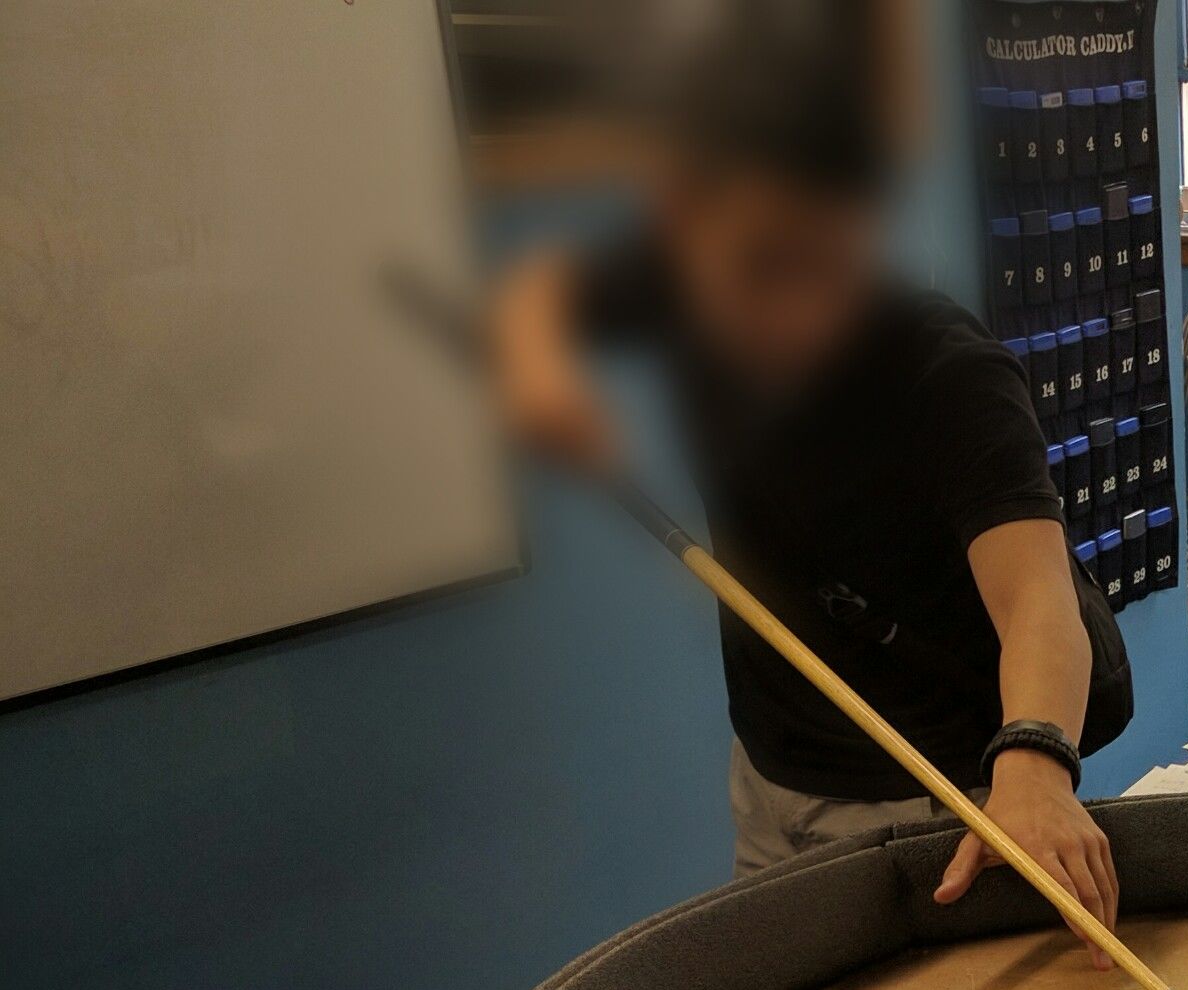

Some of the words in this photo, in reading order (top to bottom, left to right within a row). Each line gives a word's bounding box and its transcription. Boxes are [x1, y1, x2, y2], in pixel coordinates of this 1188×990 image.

[987, 34, 1077, 61] CALCULATOR
[998, 141, 1006, 158] 1
[1027, 141, 1037, 158] 2
[1056, 138, 1065, 155] 3
[1086, 135, 1095, 152] 4
[1113, 132, 1122, 148] 5
[1141, 127, 1149, 143] 6
[1005, 270, 1015, 286] 7
[1035, 266, 1045, 283] 8
[1063, 261, 1072, 278] 9
[1089, 255, 1102, 273] 10
[1117, 249, 1129, 266] 11
[1140, 242, 1154, 260] 12
[1042, 381, 1056, 398] 14
[1070, 372, 1082, 390] 15
[1096, 365, 1109, 382] 16
[1122, 356, 1134, 374] 17
[1147, 348, 1160, 365] 18
[1077, 486, 1090, 504] 21
[1102, 475, 1116, 494] 22
[1126, 465, 1140, 483] 23
[1152, 455, 1168, 473] 24
[1107, 578, 1121, 596] 28
[1133, 567, 1146, 585] 29
[1156, 555, 1171, 573] 30
